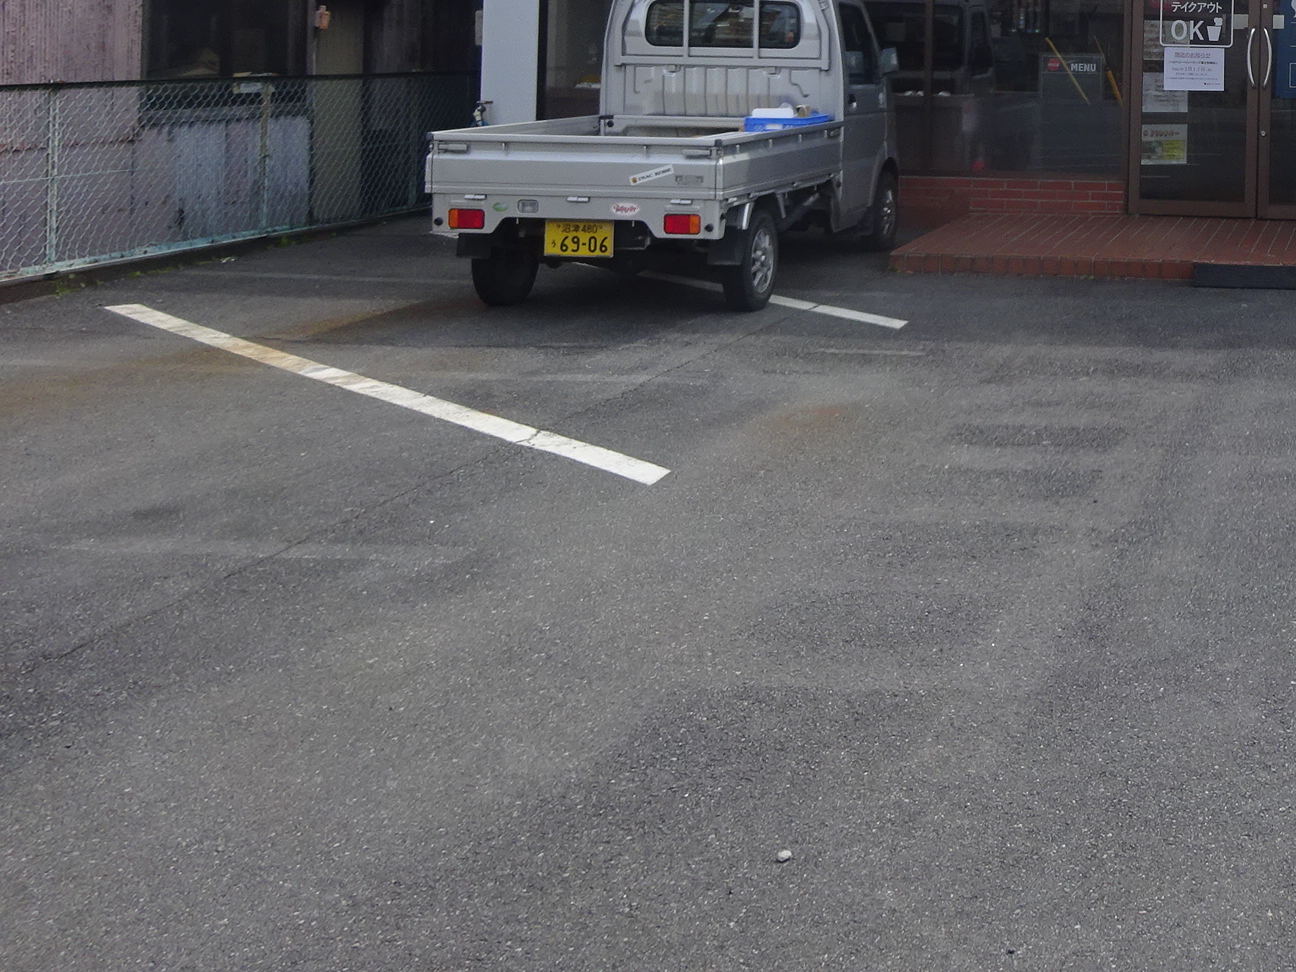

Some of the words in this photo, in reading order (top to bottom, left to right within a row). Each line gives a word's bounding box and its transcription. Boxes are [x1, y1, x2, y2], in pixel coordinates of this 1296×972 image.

[1171, 1, 1222, 14] テイクアウト
[1171, 20, 1204, 41] OK
[560, 236, 608, 253] 69-06
